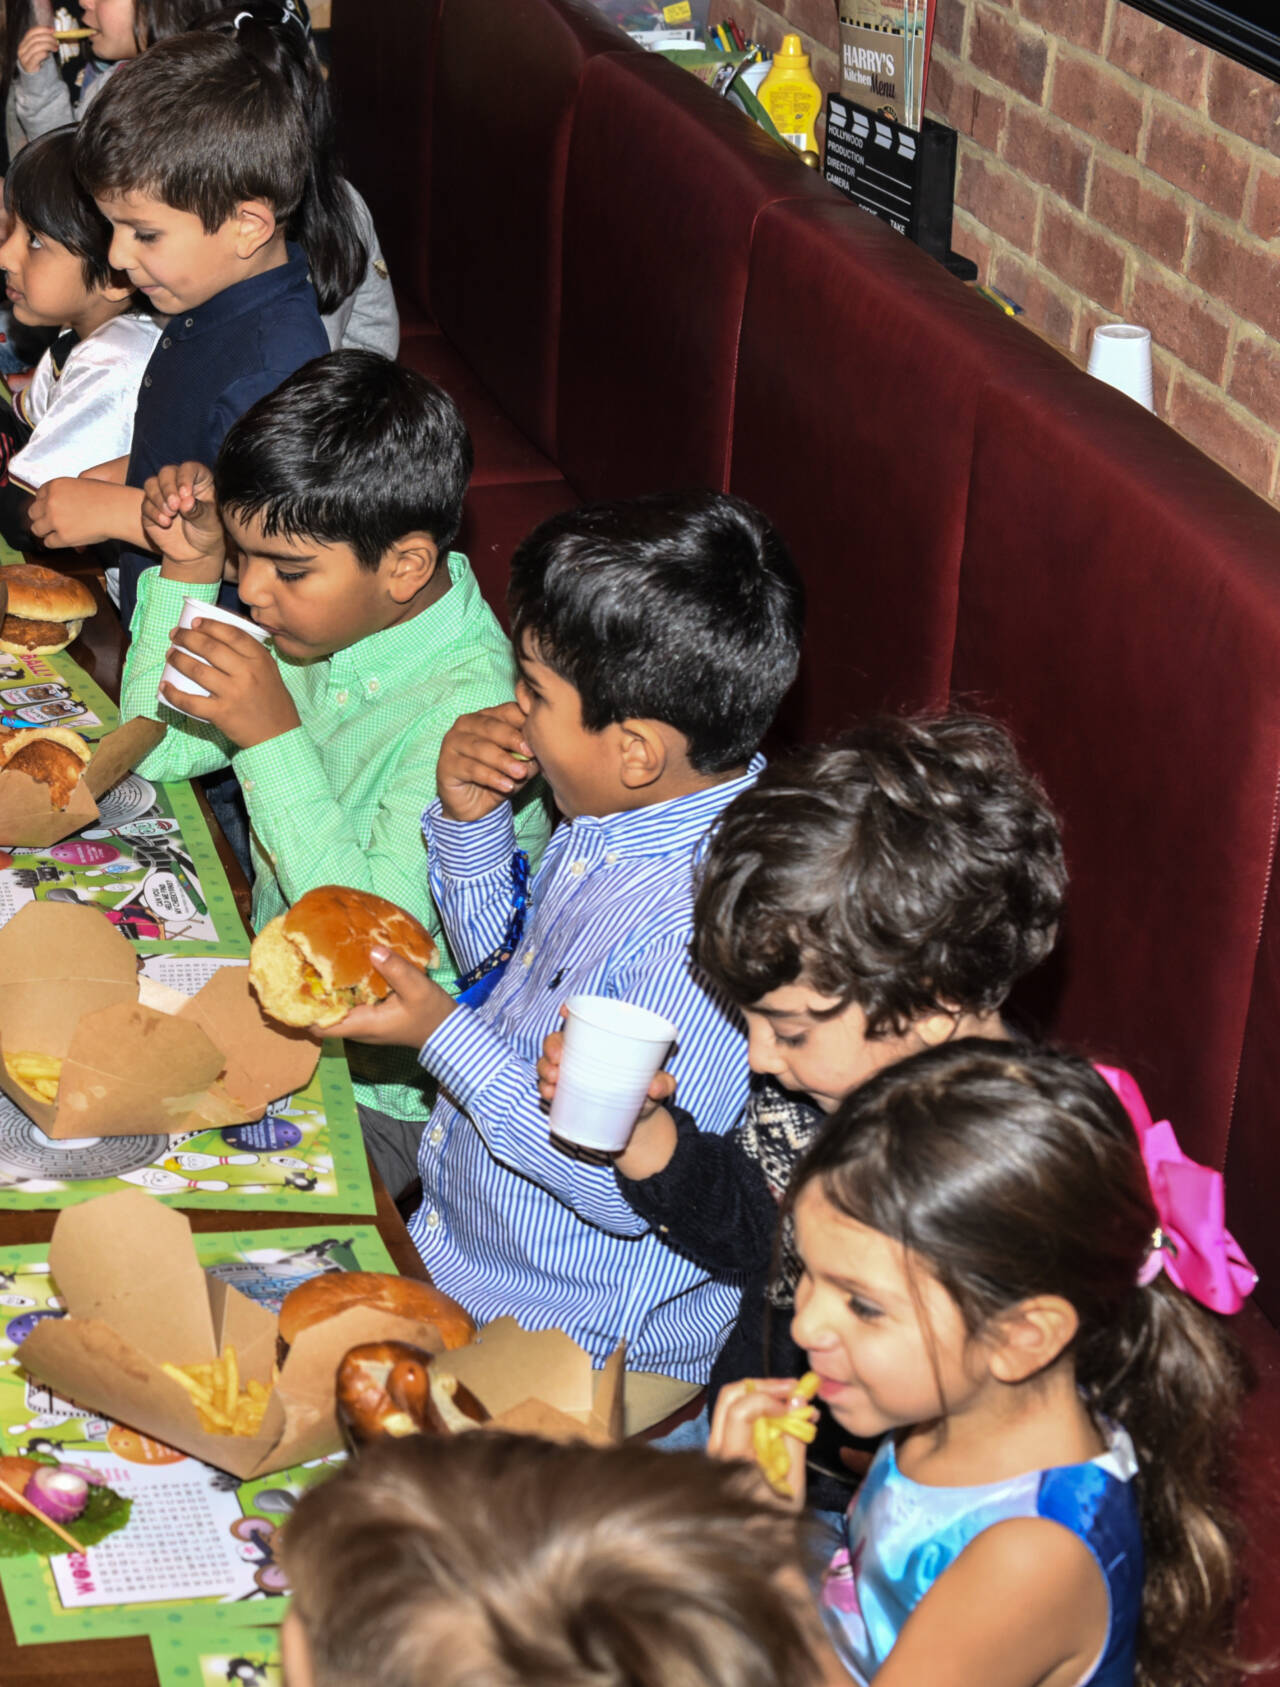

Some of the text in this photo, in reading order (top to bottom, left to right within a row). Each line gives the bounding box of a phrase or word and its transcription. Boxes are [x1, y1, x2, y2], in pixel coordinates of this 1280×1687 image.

[843, 43, 895, 76] HARRY'S
[843, 66, 896, 98] Kitchen Menu
[828, 124, 864, 149] HOLLYWOOD
[827, 140, 865, 165] PRODUCTION
[826, 156, 856, 177] DIRECTOR
[826, 172, 850, 191] CAMERA
[889, 219, 906, 235] TAKE
